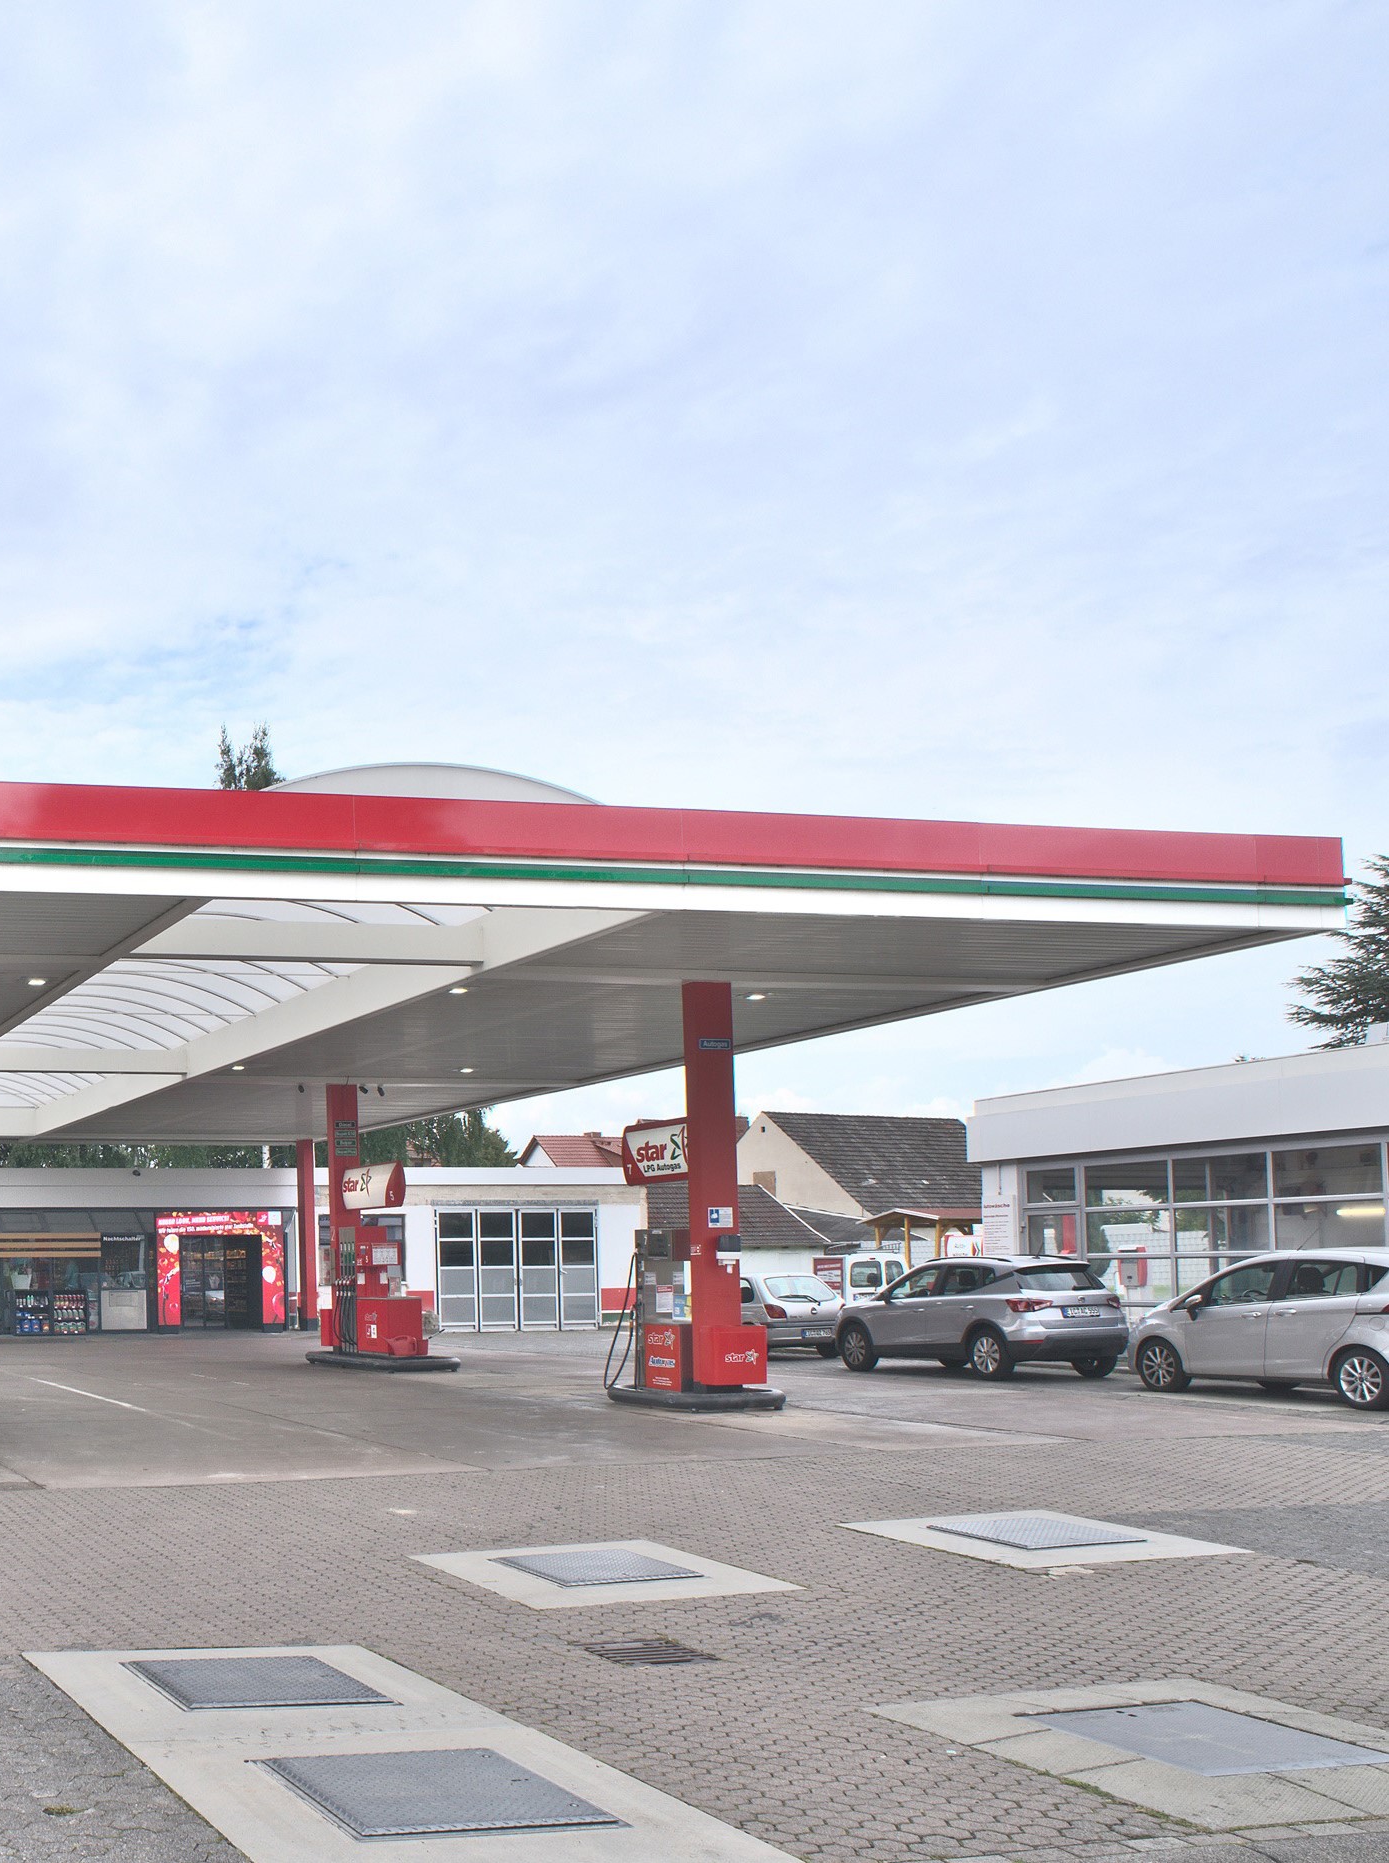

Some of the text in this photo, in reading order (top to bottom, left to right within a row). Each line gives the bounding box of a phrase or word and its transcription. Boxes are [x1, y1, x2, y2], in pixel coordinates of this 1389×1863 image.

[636, 1140, 667, 1163] star
[627, 1164, 632, 1175] 7
[643, 1163, 681, 1173] LPG Autogas
[343, 1177, 359, 1193] star
[389, 1191, 395, 1201] 5
[648, 1332, 664, 1345] star
[725, 1352, 745, 1363] star
